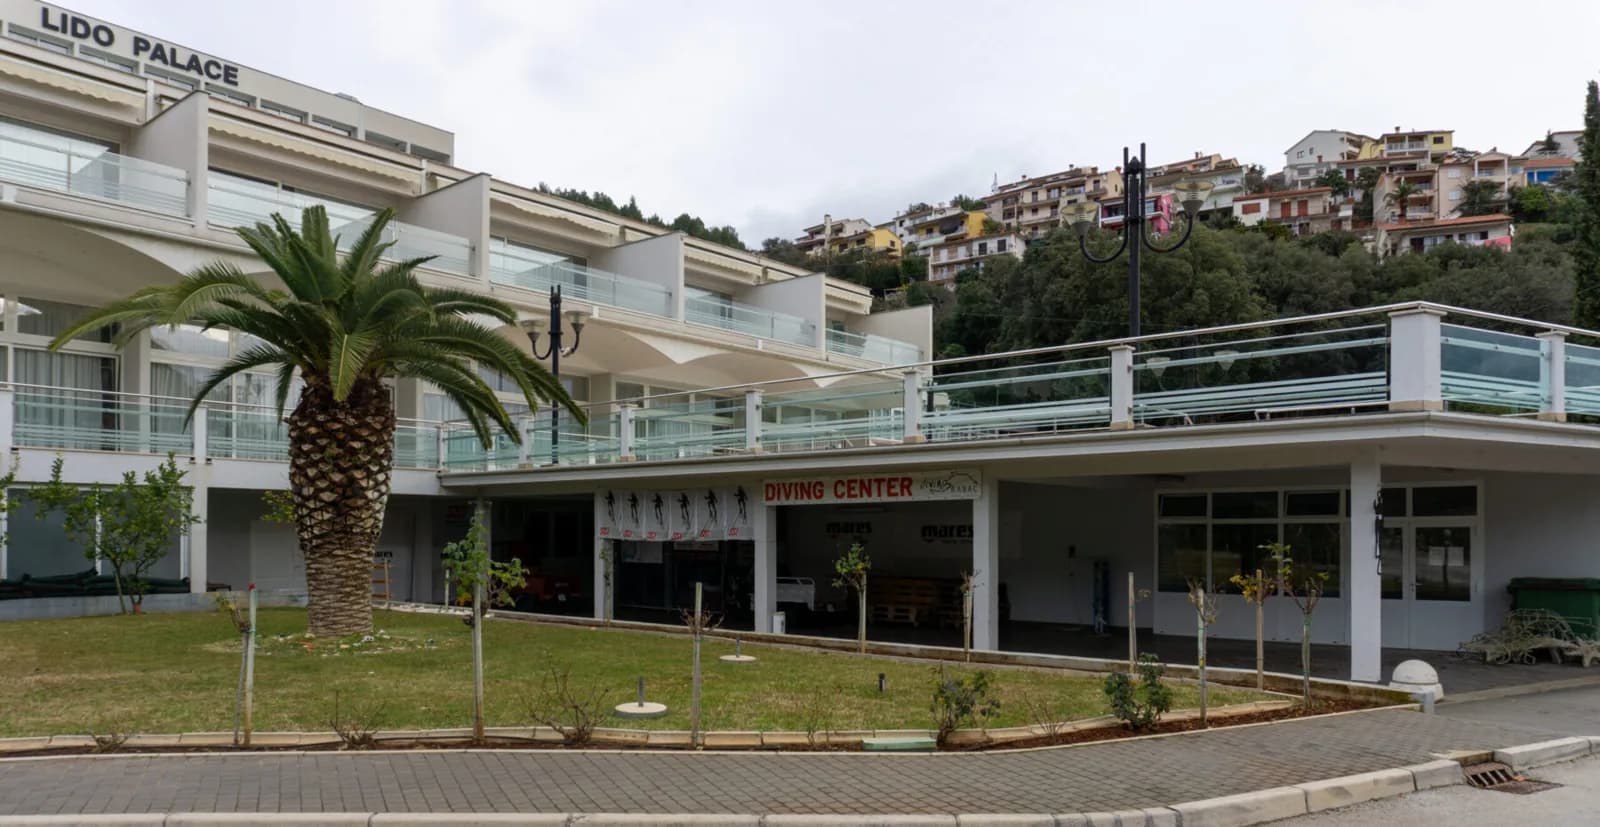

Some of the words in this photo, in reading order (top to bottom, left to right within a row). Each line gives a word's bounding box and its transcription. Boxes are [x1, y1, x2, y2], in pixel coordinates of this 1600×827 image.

[41, 7, 115, 47] LIDO
[133, 36, 239, 86] PALACE
[765, 481, 825, 502] DIVING
[833, 476, 913, 498] CENTER
